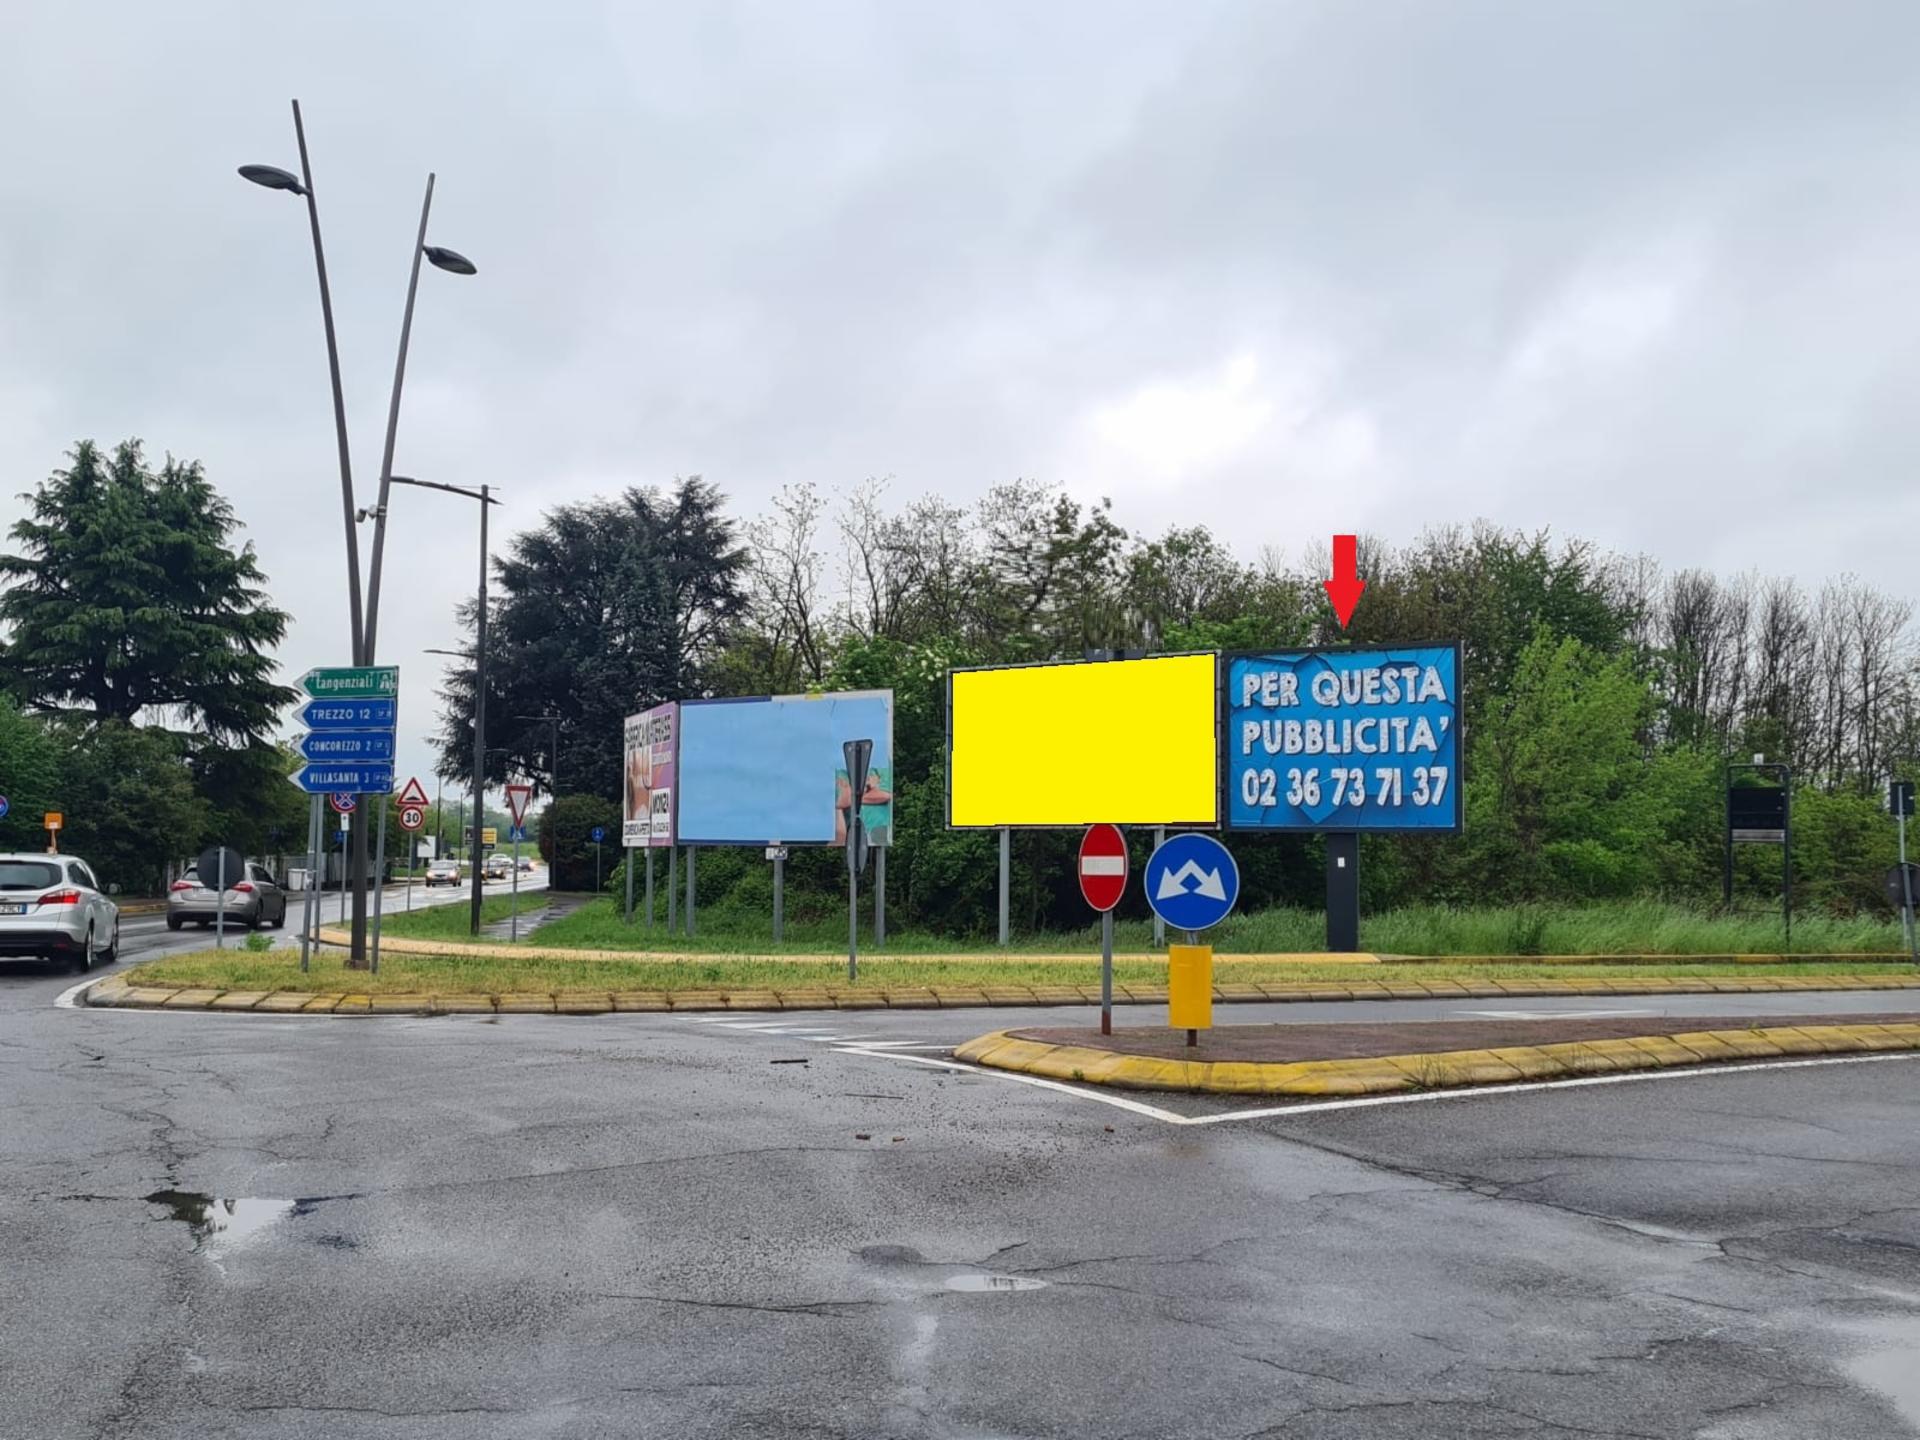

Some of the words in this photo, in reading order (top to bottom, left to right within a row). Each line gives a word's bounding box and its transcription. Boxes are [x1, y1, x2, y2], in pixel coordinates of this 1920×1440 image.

[1242, 671, 1299, 707] PER
[1311, 666, 1447, 707] QUESTA
[311, 708, 354, 720] TREZZO
[359, 708, 371, 720] 12
[1242, 715, 1449, 755] PUBBLICITA'
[309, 741, 361, 752] CONCOREZZO
[365, 741, 371, 752] 2
[309, 773, 360, 784] VILLASANTA
[365, 773, 370, 784] 3
[1241, 768, 1277, 806] 02
[1286, 768, 1321, 806] 36
[1331, 768, 1366, 806] 73
[1376, 767, 1402, 806] 71
[1412, 766, 1448, 805] 37
[405, 812, 420, 823] 30
